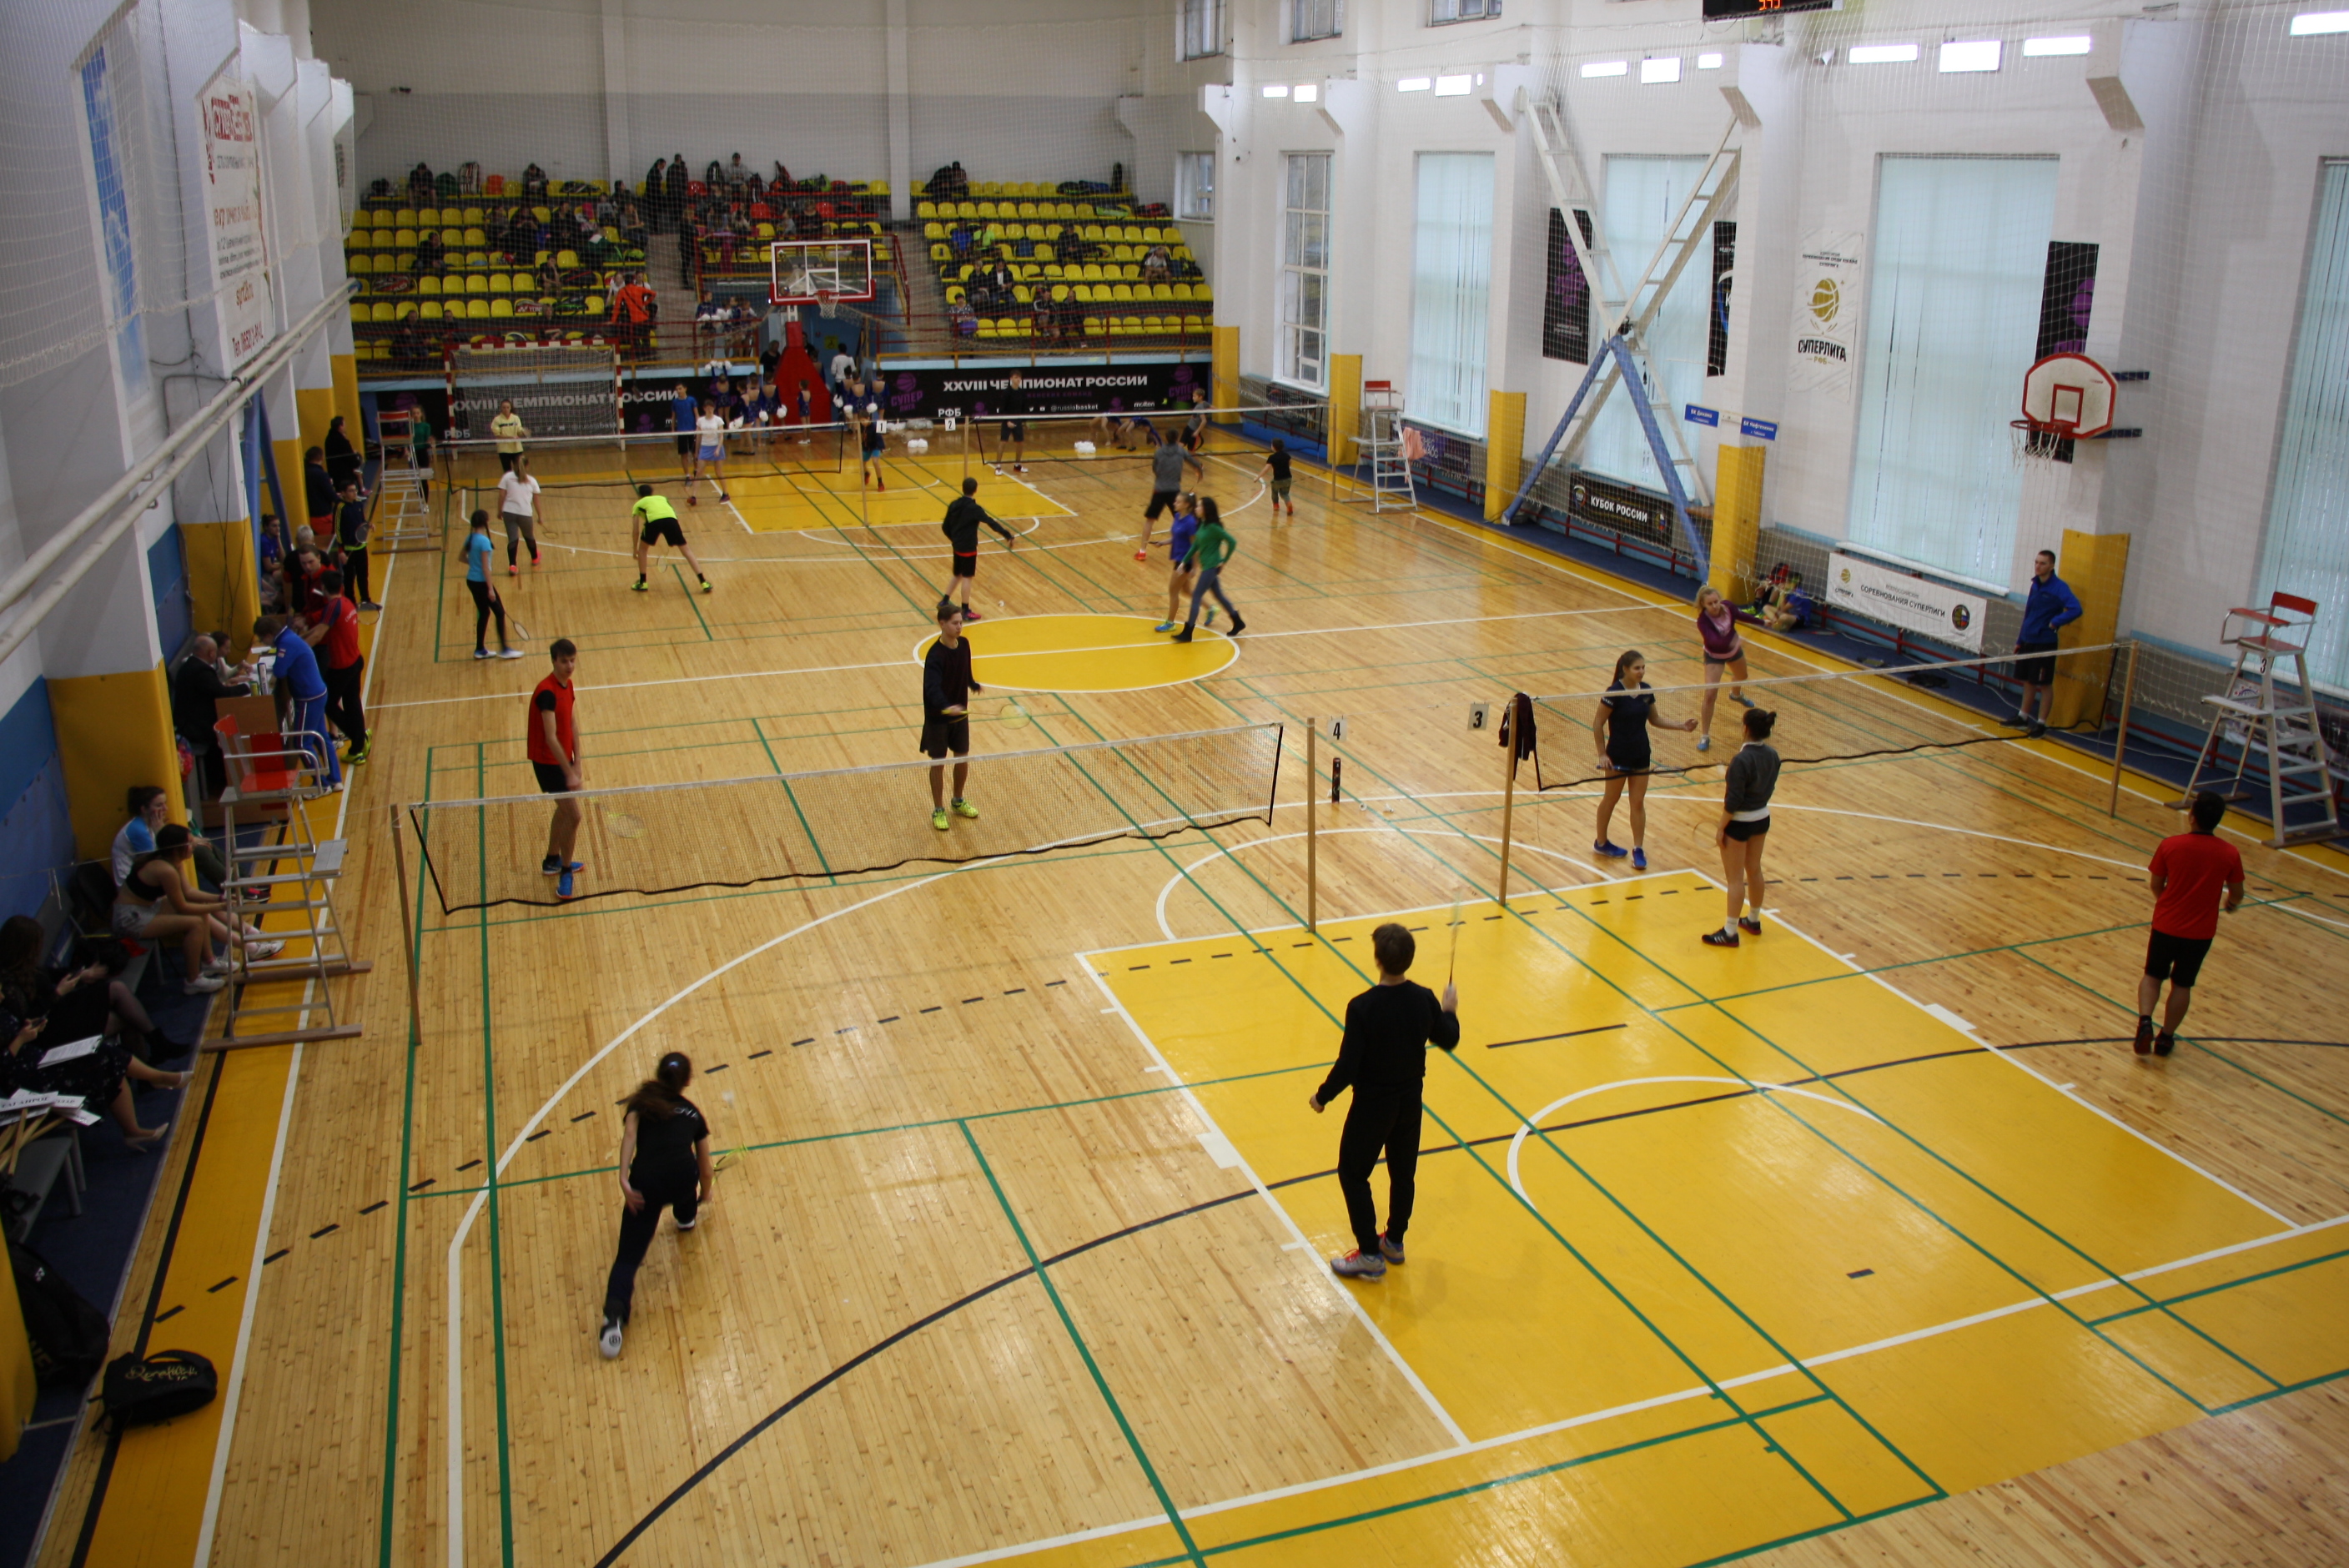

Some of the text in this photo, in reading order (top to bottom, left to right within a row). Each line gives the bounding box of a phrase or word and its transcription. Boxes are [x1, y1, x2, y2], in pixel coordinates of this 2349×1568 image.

[1798, 339, 1847, 363] СУПЕРЛИГА
[1813, 355, 1828, 365] РФБ
[943, 379, 988, 392] XXVIII
[1086, 375, 1148, 387] РОССИИ
[511, 393, 607, 409] ЕМПИОНАТ
[891, 390, 923, 407] СУПЕР
[899, 403, 916, 412] ЛИГА
[938, 408, 962, 417] РФБ
[1050, 404, 1099, 413] @russiabasket
[948, 420, 953, 430] 2
[1591, 495, 1647, 523] КУБОК РОССИИ
[1860, 584, 1945, 618] СОРЕВНОВАНИЯ СУПЕРЛИГИ
[2260, 658, 2267, 674] 3
[1472, 711, 1483, 729] 3
[1332, 721, 1341, 741] 4
